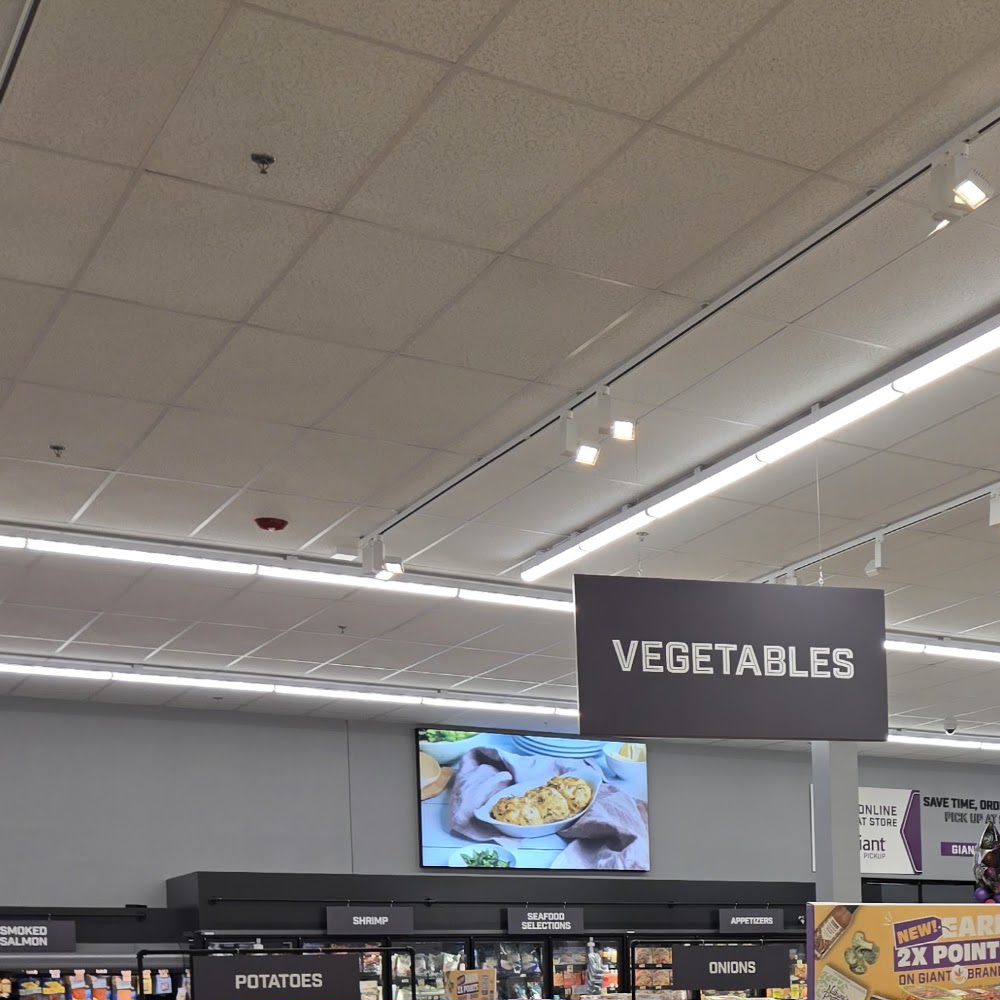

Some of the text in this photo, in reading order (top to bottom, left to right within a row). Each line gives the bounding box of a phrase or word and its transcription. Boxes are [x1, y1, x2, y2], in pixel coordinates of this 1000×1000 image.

[611, 639, 855, 679] VEGETABLES
[858, 804, 897, 816] ONLINE
[923, 796, 949, 808] SAVE
[950, 798, 978, 812] TIME,
[868, 817, 898, 828] STORE
[944, 812, 970, 823] PICK
[972, 813, 984, 824] UP
[985, 813, 995, 825] AT
[859, 835, 885, 852] iant
[863, 852, 886, 860] PICKUP
[352, 916, 389, 926] SHRIMP
[527, 912, 565, 921] SEAFOOD
[730, 916, 773, 925] APPETIZERS
[0, 926, 48, 936] SMOKED
[521, 921, 572, 930] SELECTIONS
[896, 920, 938, 944] NEW!
[0, 936, 48, 947] SALMON
[896, 946, 928, 967] 2X
[709, 961, 756, 974] ONIONS
[235, 973, 323, 990] POTATOES
[899, 974, 915, 985] ON
[918, 970, 952, 984] GIANT
